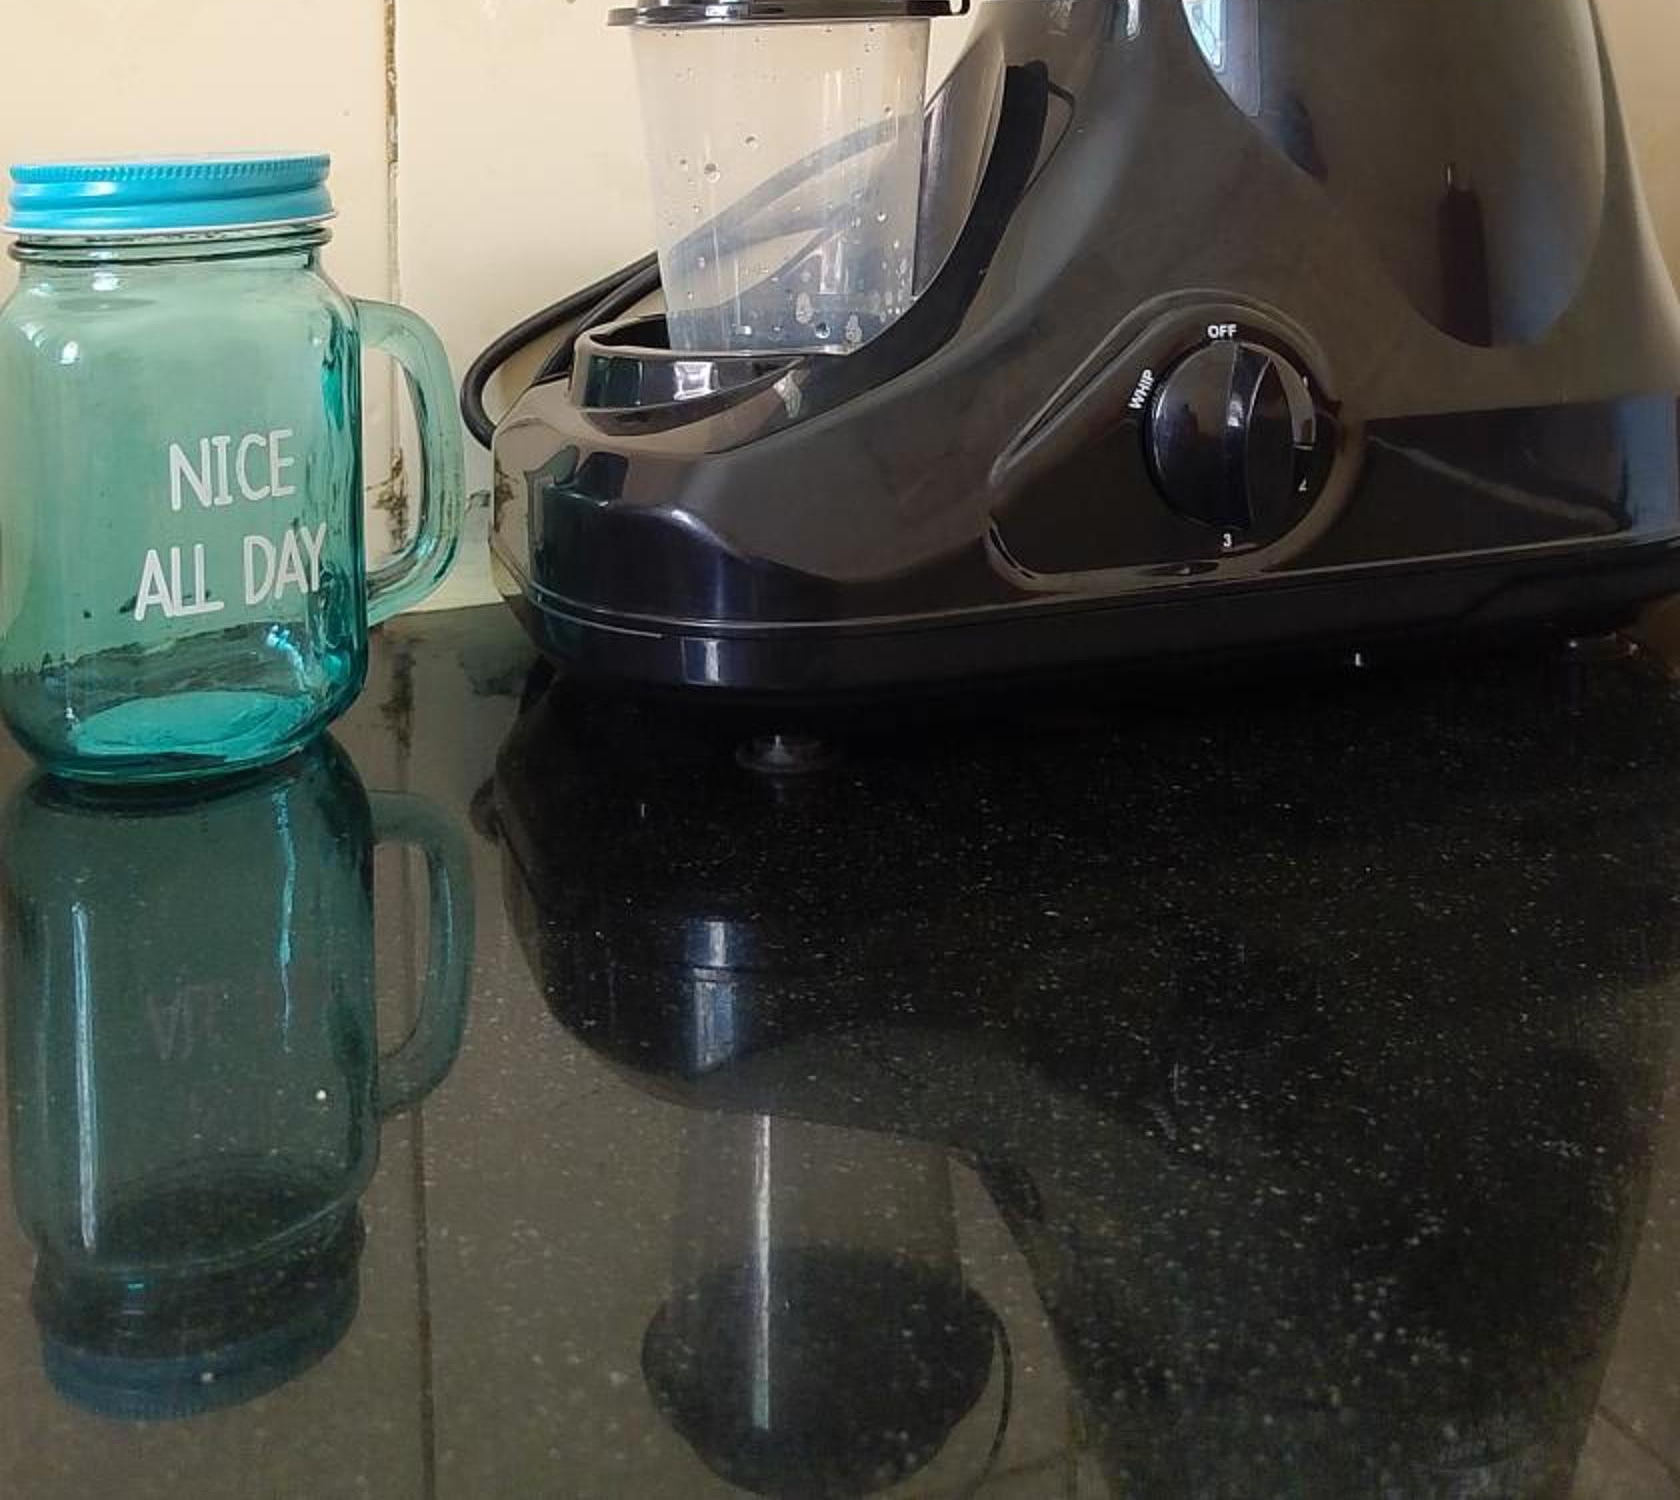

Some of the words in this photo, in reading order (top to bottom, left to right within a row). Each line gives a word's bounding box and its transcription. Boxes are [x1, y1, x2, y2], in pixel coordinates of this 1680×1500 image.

[1207, 324, 1237, 338] OFF
[1128, 369, 1154, 409] WHIP
[169, 429, 296, 511] NICE
[1223, 533, 1232, 547] 3
[134, 543, 225, 621] ALL
[243, 521, 327, 605] DAY
